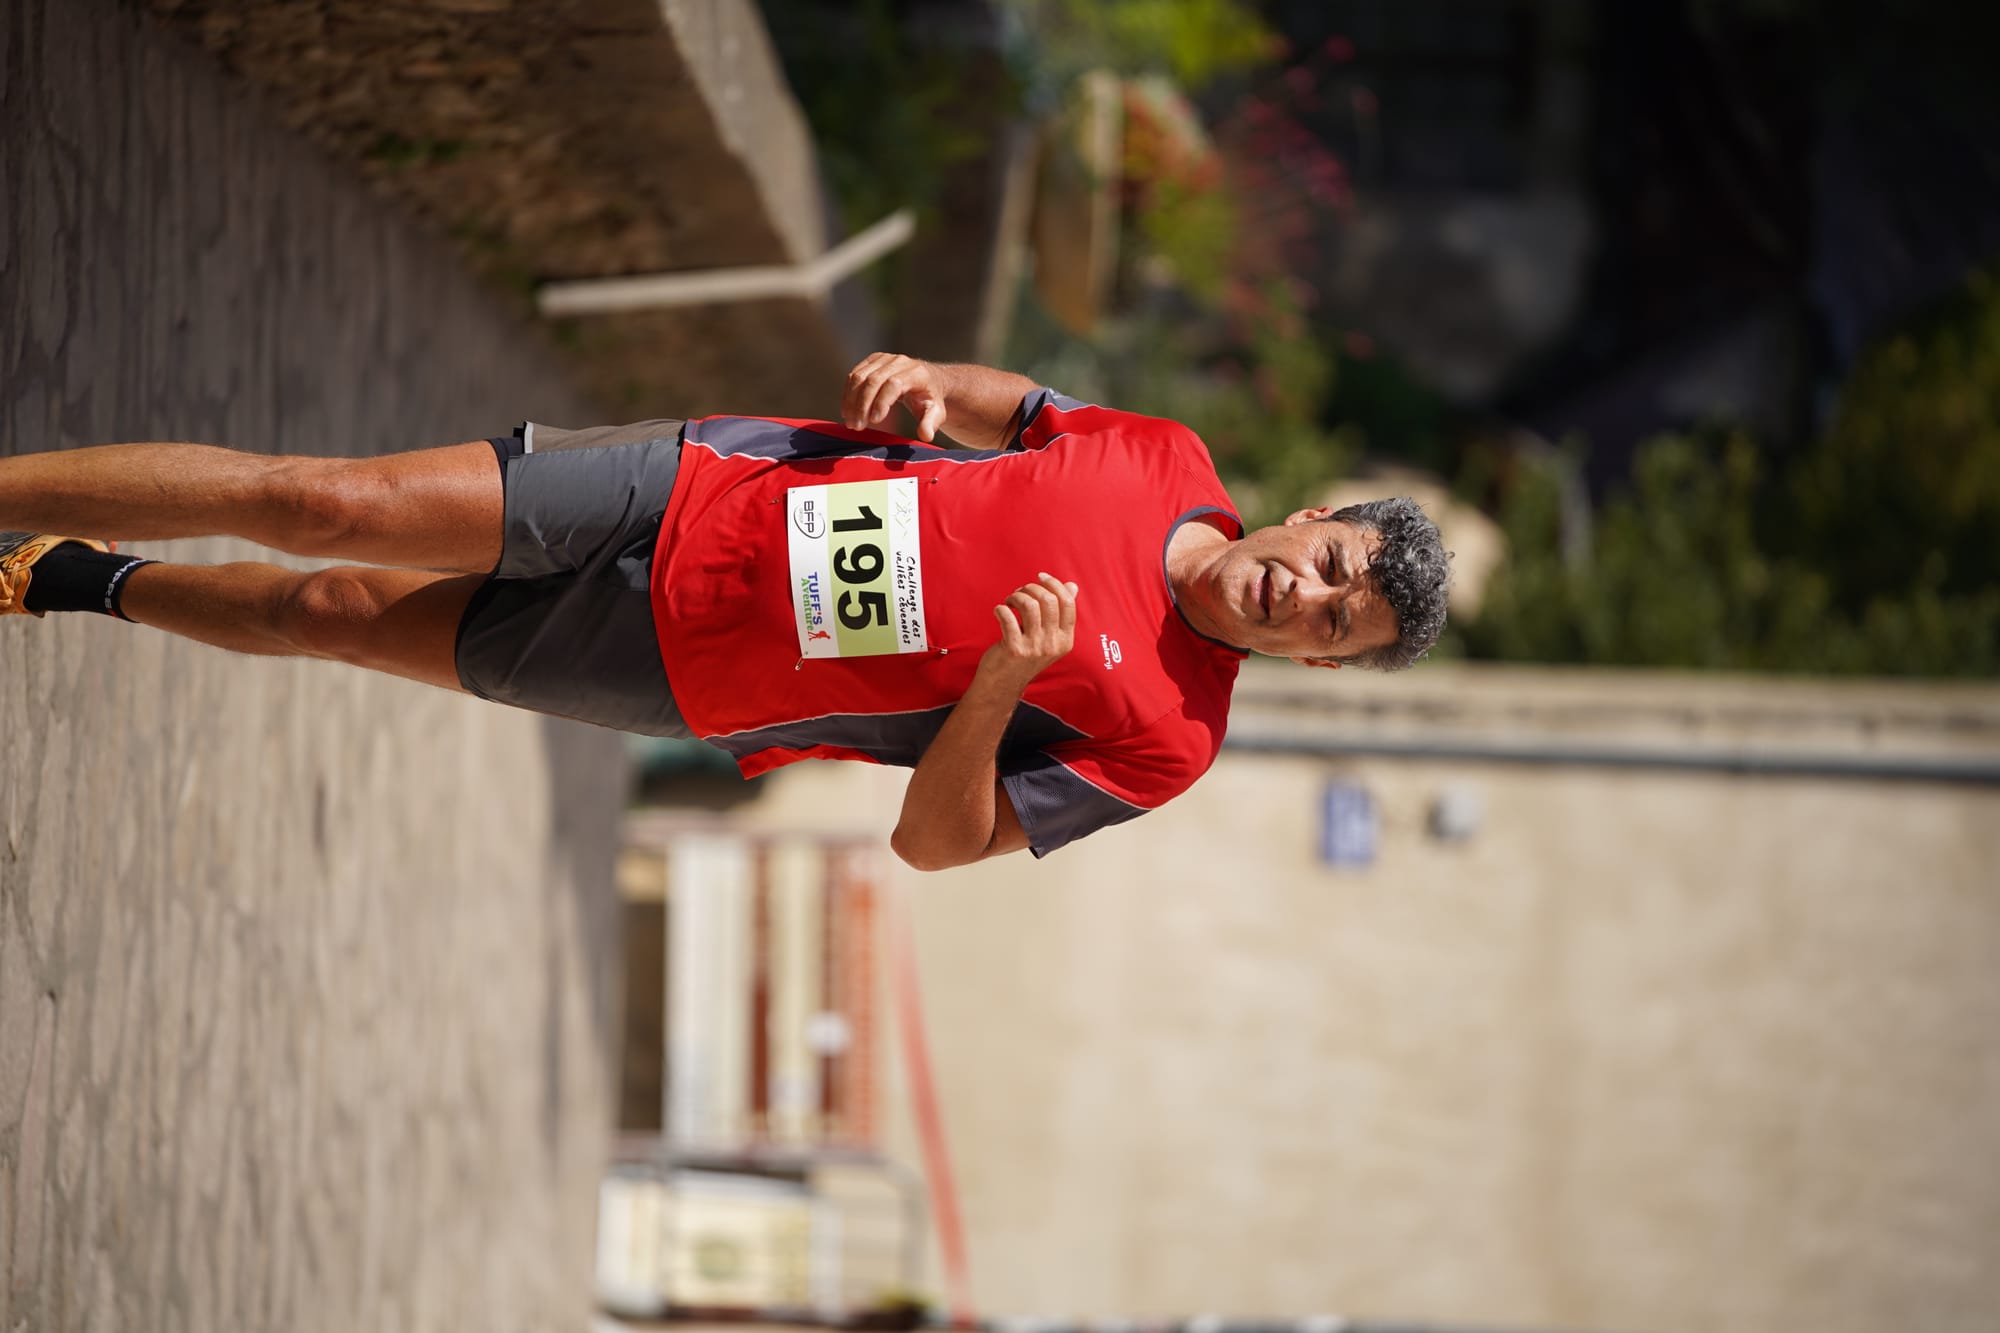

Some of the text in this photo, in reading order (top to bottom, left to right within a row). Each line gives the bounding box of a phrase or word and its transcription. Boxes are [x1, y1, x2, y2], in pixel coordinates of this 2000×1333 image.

[803, 500, 815, 533] BFP
[808, 571, 823, 625] TUFF'S
[832, 505, 889, 631] 195
[896, 551, 911, 645] vallées cévenoles
[906, 556, 921, 638] Challenge des
[801, 577, 814, 631] Aventure
